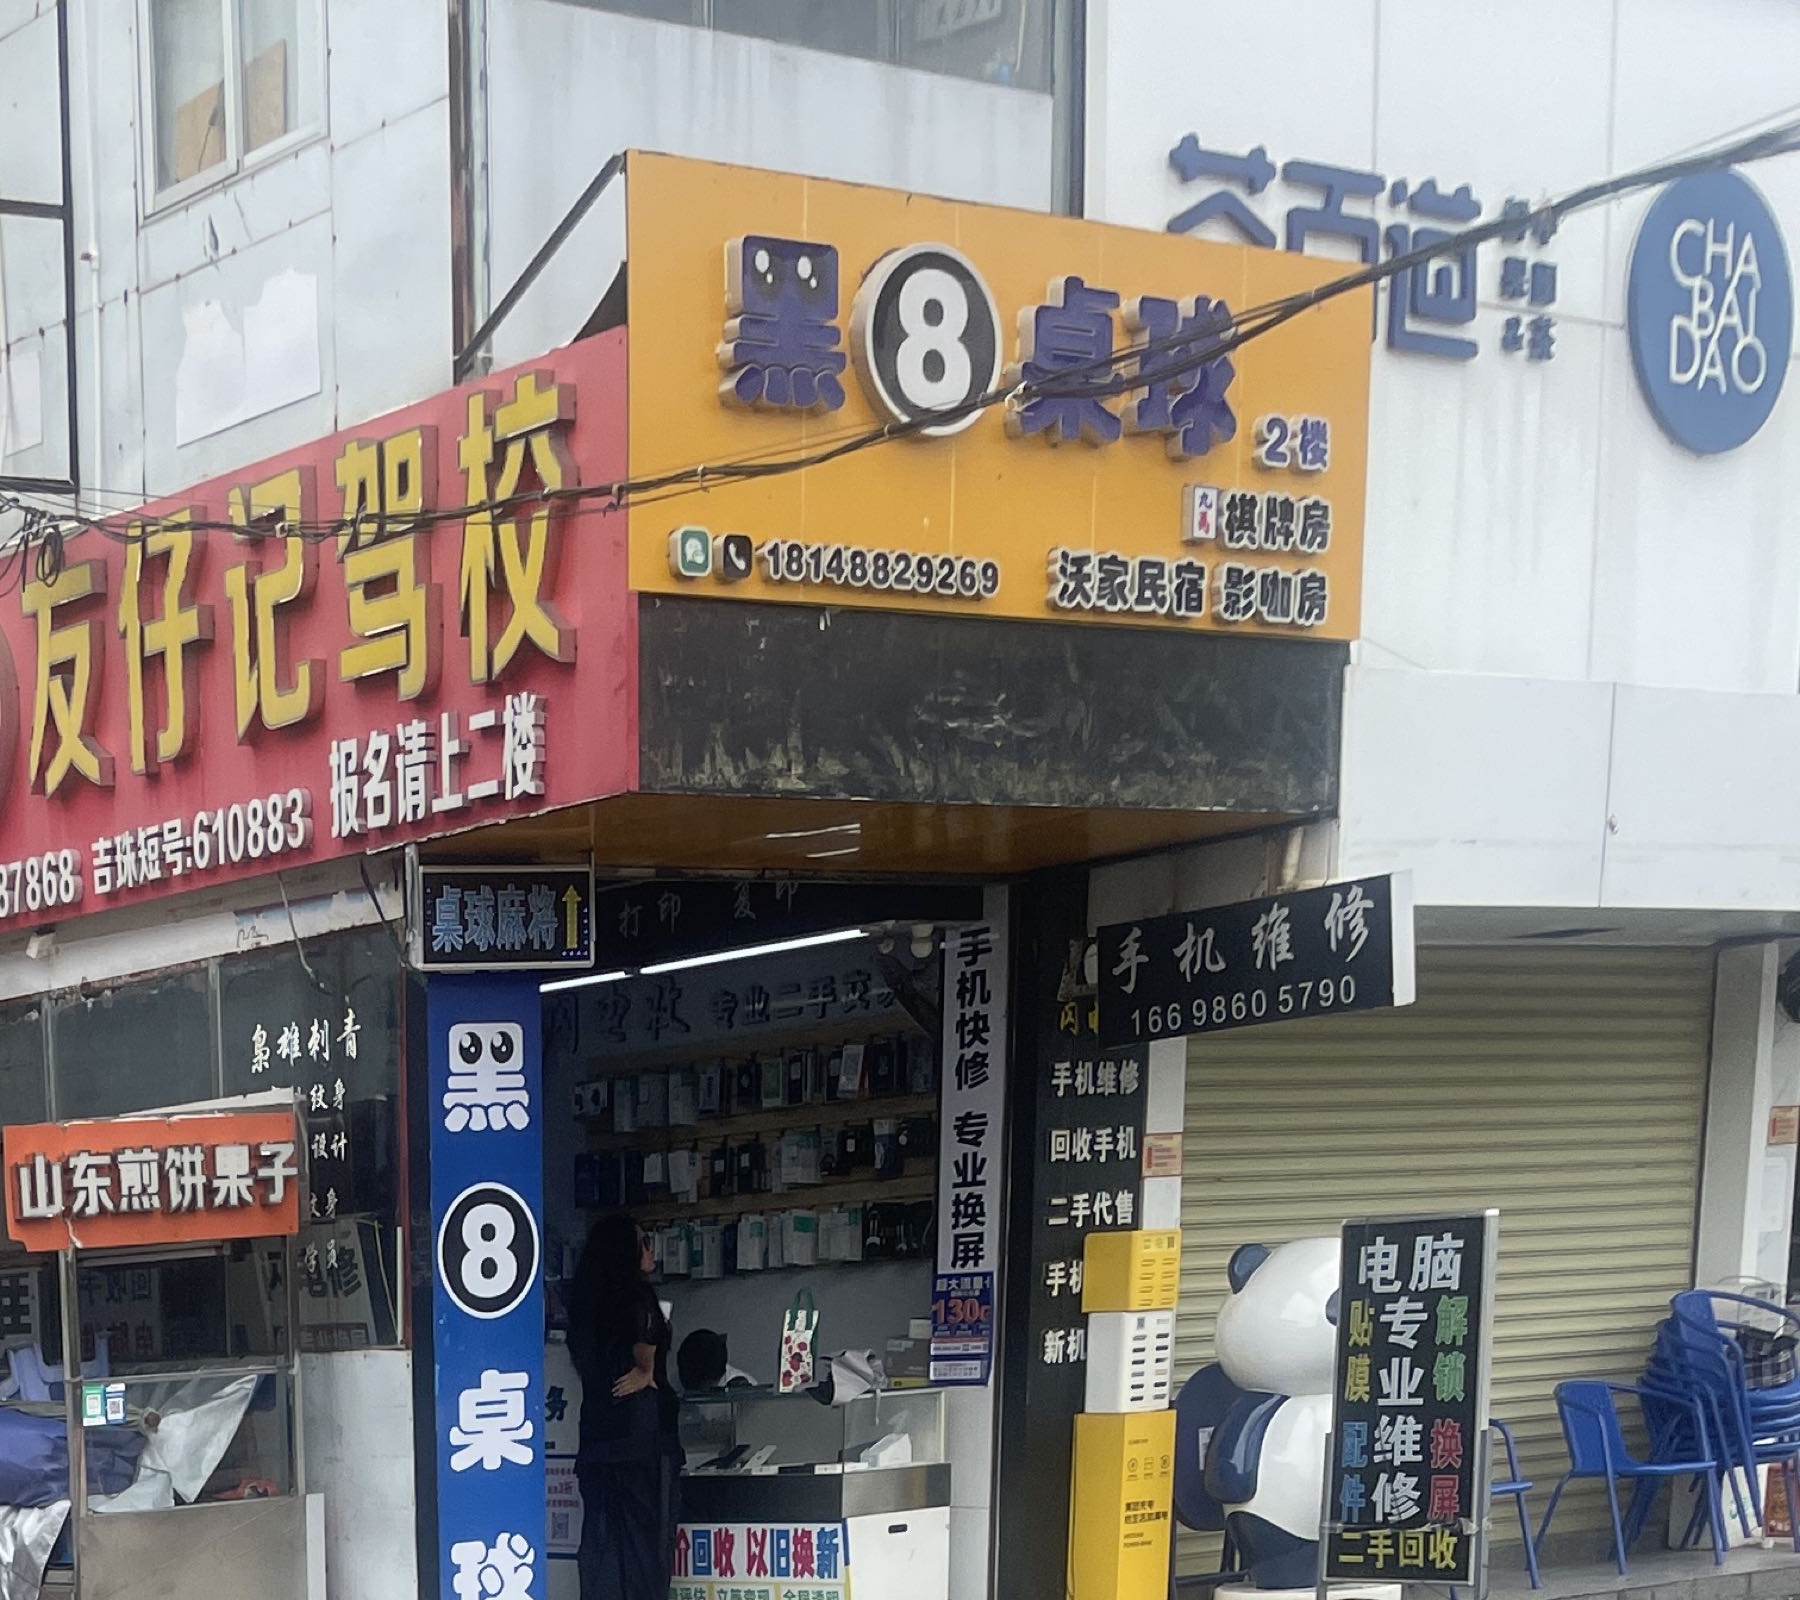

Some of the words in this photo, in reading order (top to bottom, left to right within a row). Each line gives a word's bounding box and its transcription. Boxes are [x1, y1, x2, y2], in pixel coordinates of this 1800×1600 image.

[1669, 216, 1762, 286] CHA
[1692, 274, 1760, 340] BAI
[1669, 314, 1768, 394] DAO
[1262, 416, 1329, 473] 2楼
[1225, 491, 1331, 551] 棋牌房
[20, 369, 578, 799] 友仔记驾校
[765, 540, 1001, 598] 18148829269
[1056, 550, 1206, 614] 沃家民宿
[330, 692, 540, 840] 报名请上二楼
[91, 787, 307, 892] 吉珠短号:610883
[1111, 884, 1376, 994] 手机维修
[954, 926, 994, 1091] 手机快修
[1130, 1002, 1182, 1037] 166
[1192, 988, 1268, 1028] 9860
[1277, 974, 1357, 1015] 5790
[1051, 1058, 1141, 1098] 手机维修
[311, 1131, 349, 1162] 设计
[1049, 1124, 1137, 1165] 回收手机
[15, 1142, 299, 1221] 山东煎饼果子
[950, 1110, 991, 1270] 专业换屏
[1047, 1189, 1135, 1230] 二手代售
[1357, 1231, 1466, 1295] 电脑
[1343, 1298, 1376, 1404] 贴膜
[1370, 1294, 1429, 1525] 专业维修
[1432, 1293, 1470, 1404] 解锁
[1338, 1419, 1368, 1525] 配件
[1426, 1416, 1464, 1525] 换屏
[746, 1526, 840, 1580] 以旧换新
[1338, 1527, 1459, 1571] 二手回收
